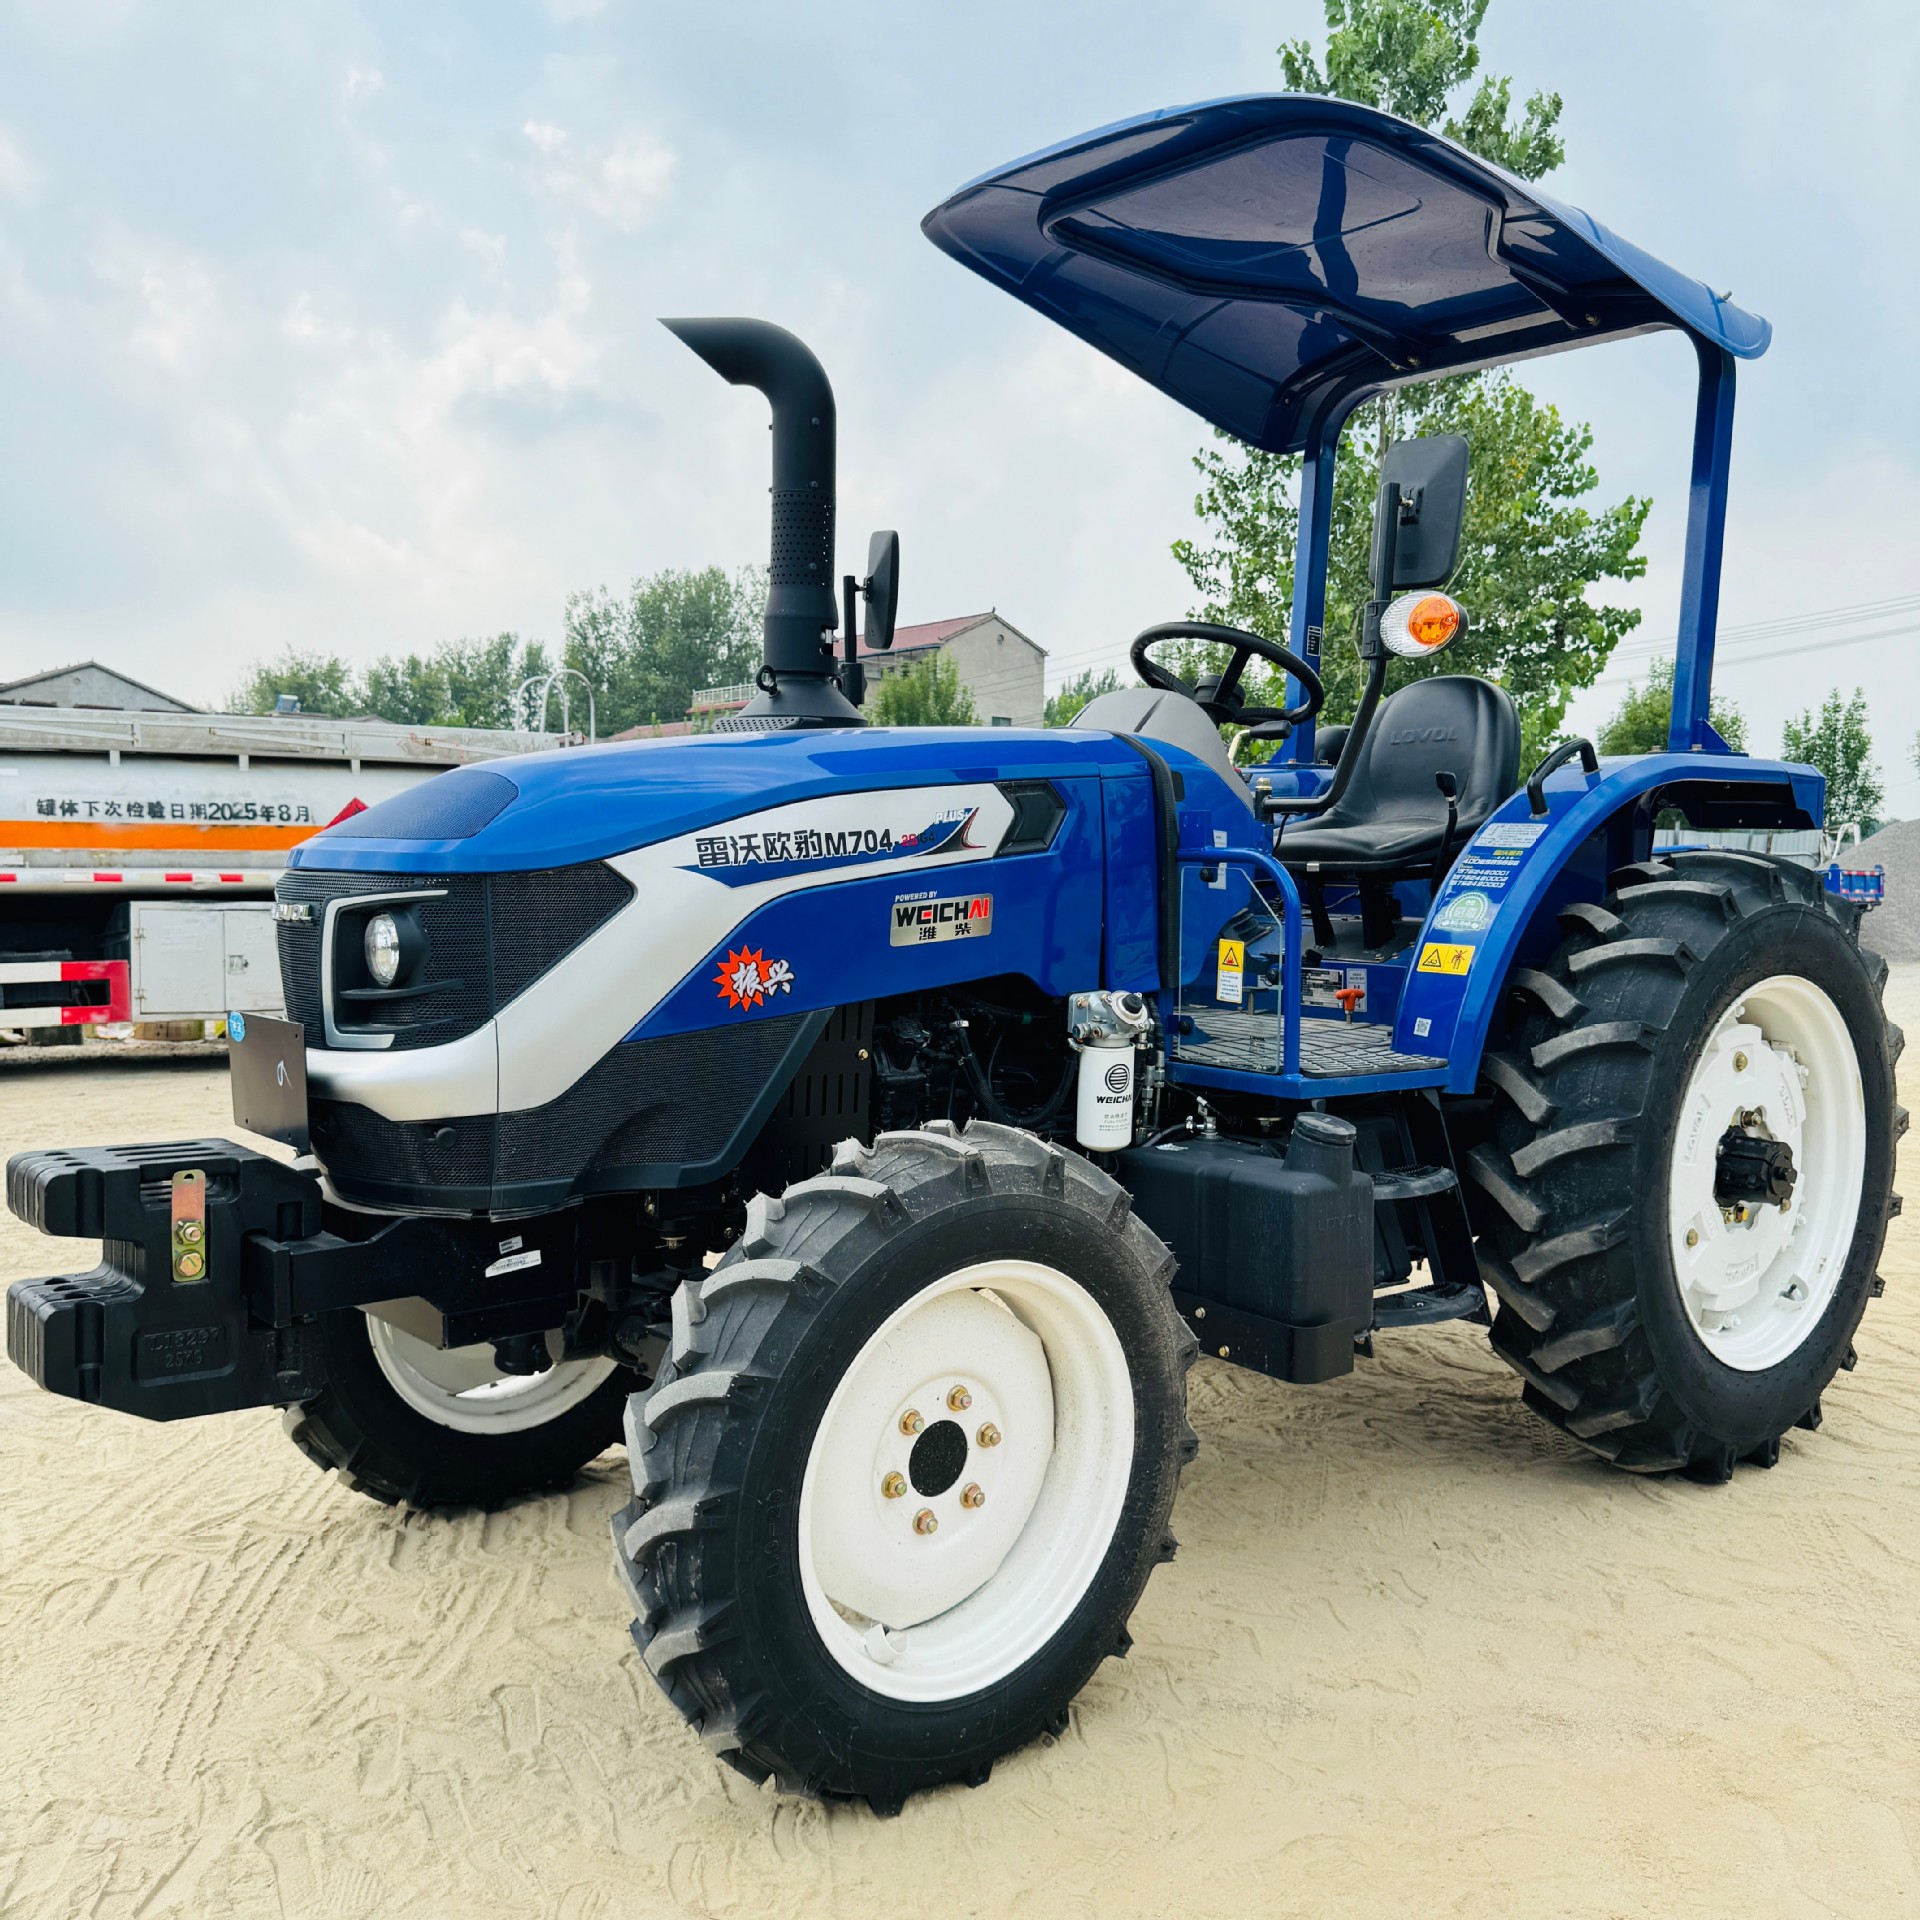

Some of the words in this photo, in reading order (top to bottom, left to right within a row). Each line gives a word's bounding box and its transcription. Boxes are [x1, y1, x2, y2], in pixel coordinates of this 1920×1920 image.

[36, 798, 311, 824] 罐体下次检验日期2025年8月
[895, 892, 928, 902] POWERED
[928, 890, 938, 898] BY
[895, 897, 990, 927] WEICHAI
[730, 959, 795, 999] 振兴
